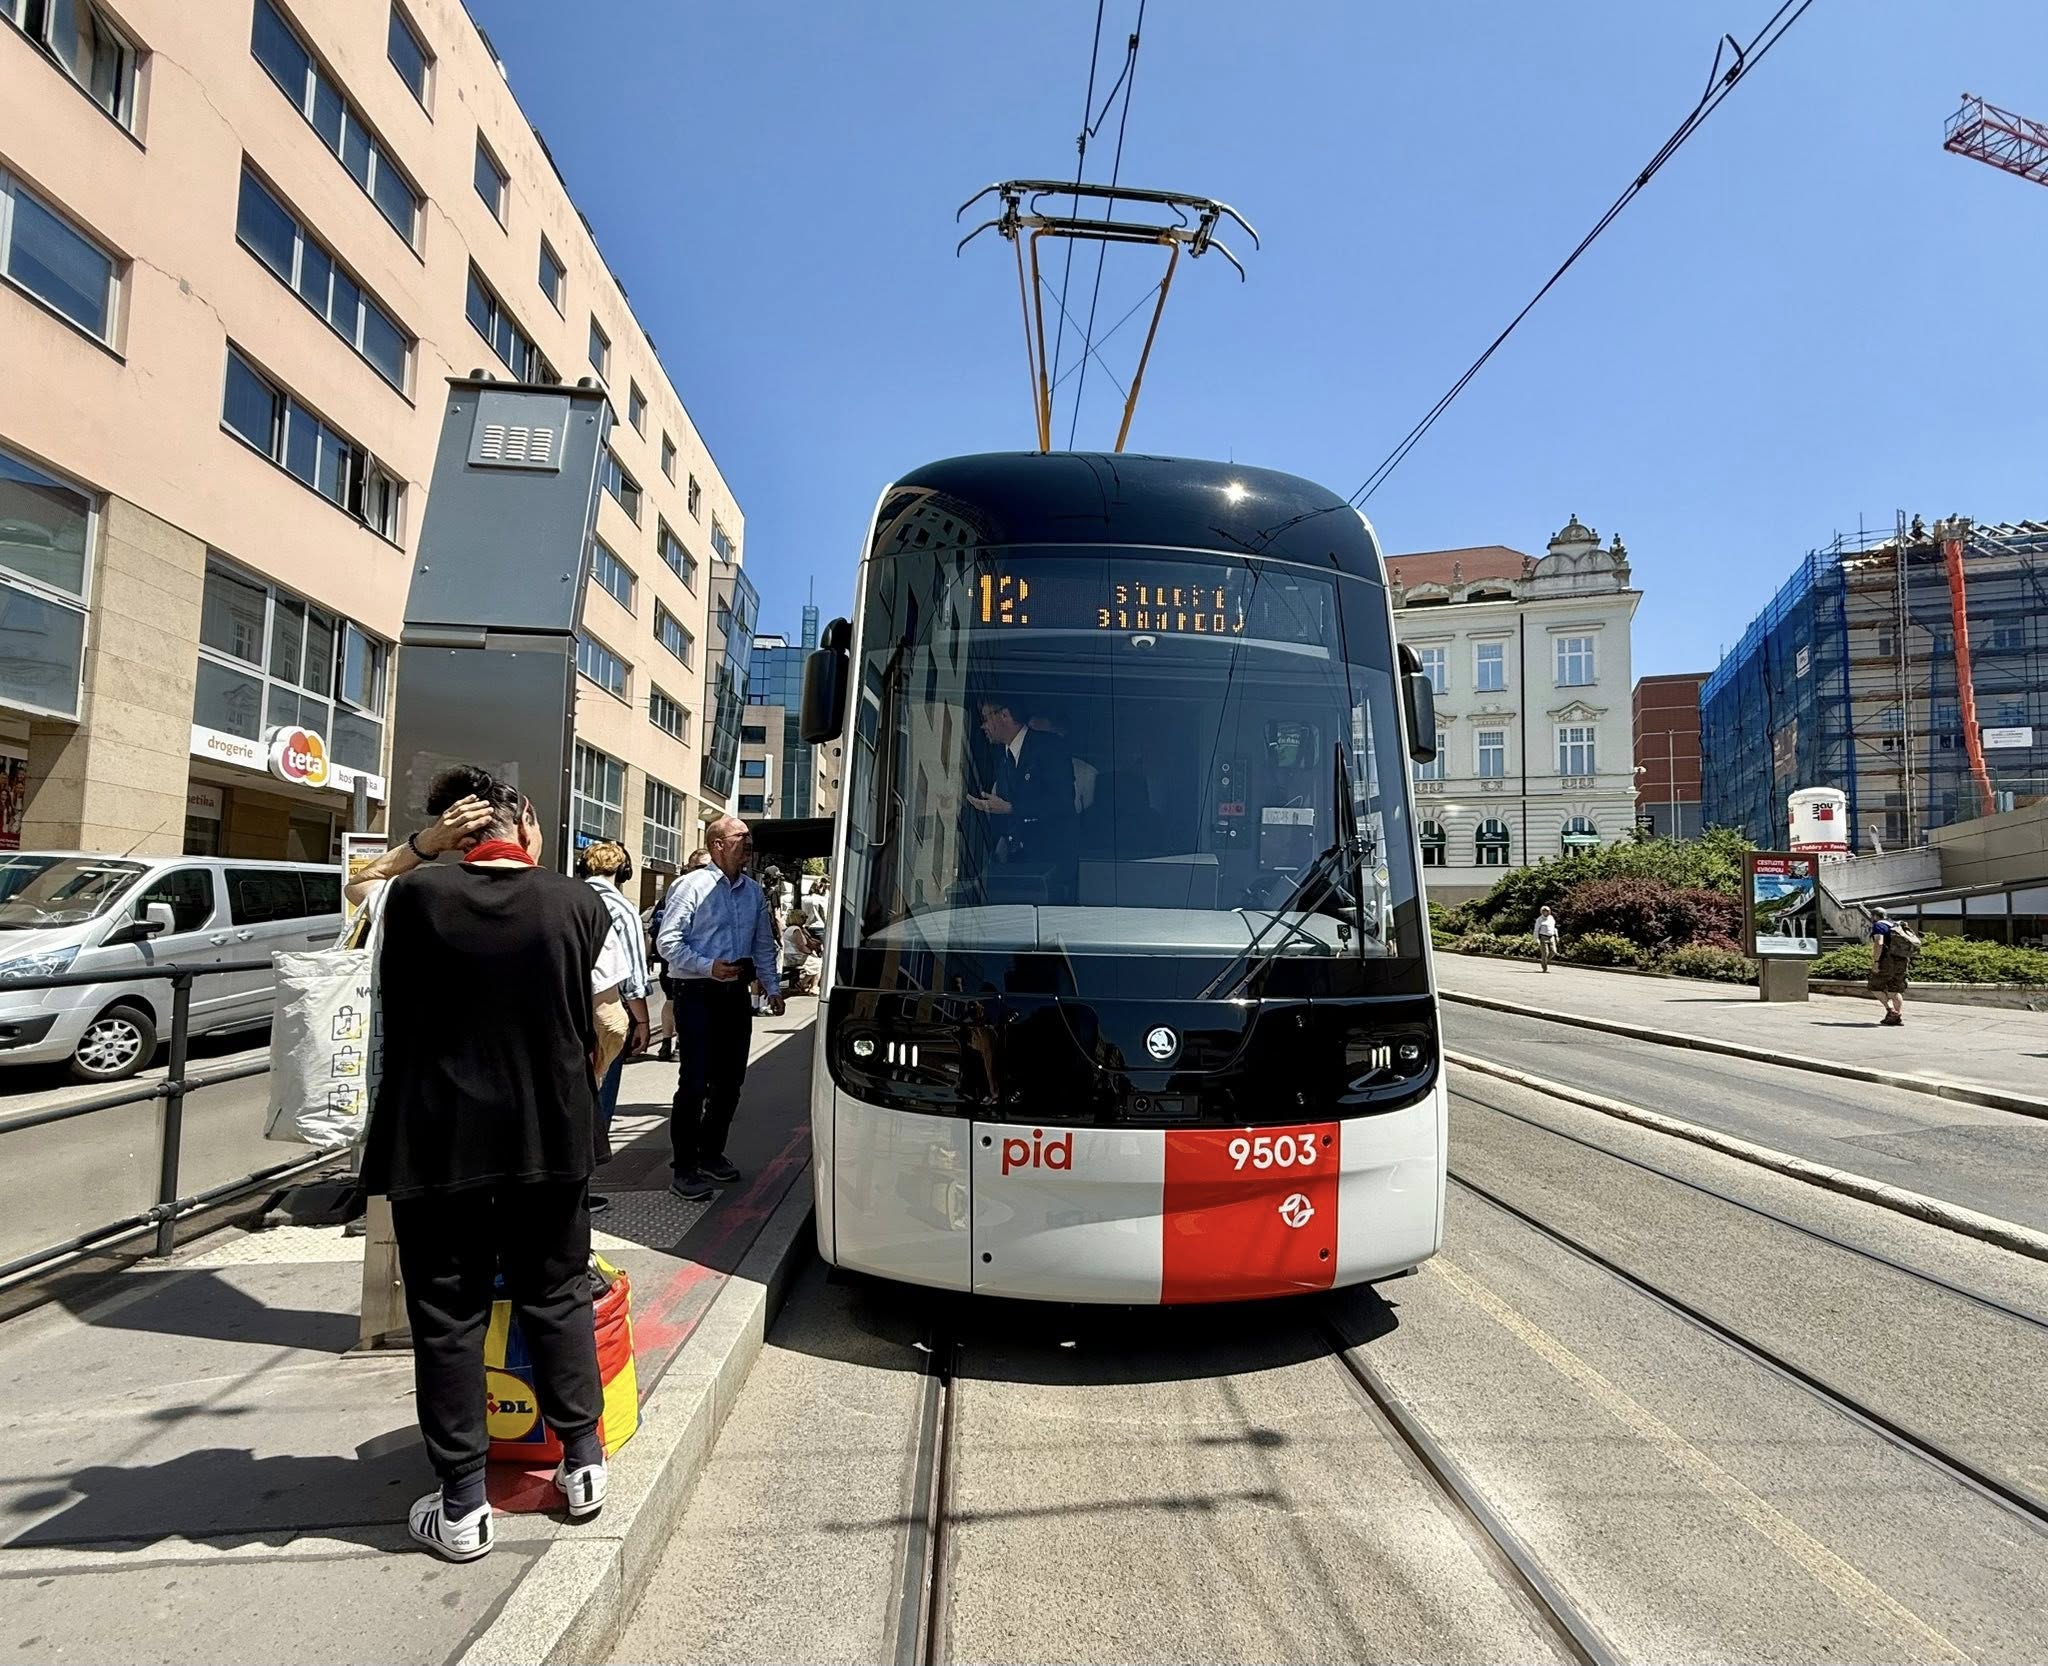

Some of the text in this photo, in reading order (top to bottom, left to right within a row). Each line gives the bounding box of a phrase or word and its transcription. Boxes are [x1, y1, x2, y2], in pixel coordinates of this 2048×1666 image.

[980, 574, 1028, 624] 12
[207, 735, 254, 758] drogerie
[287, 747, 323, 774] teta
[1002, 1129, 1072, 1175] pid
[1228, 1133, 1317, 1170] 9503
